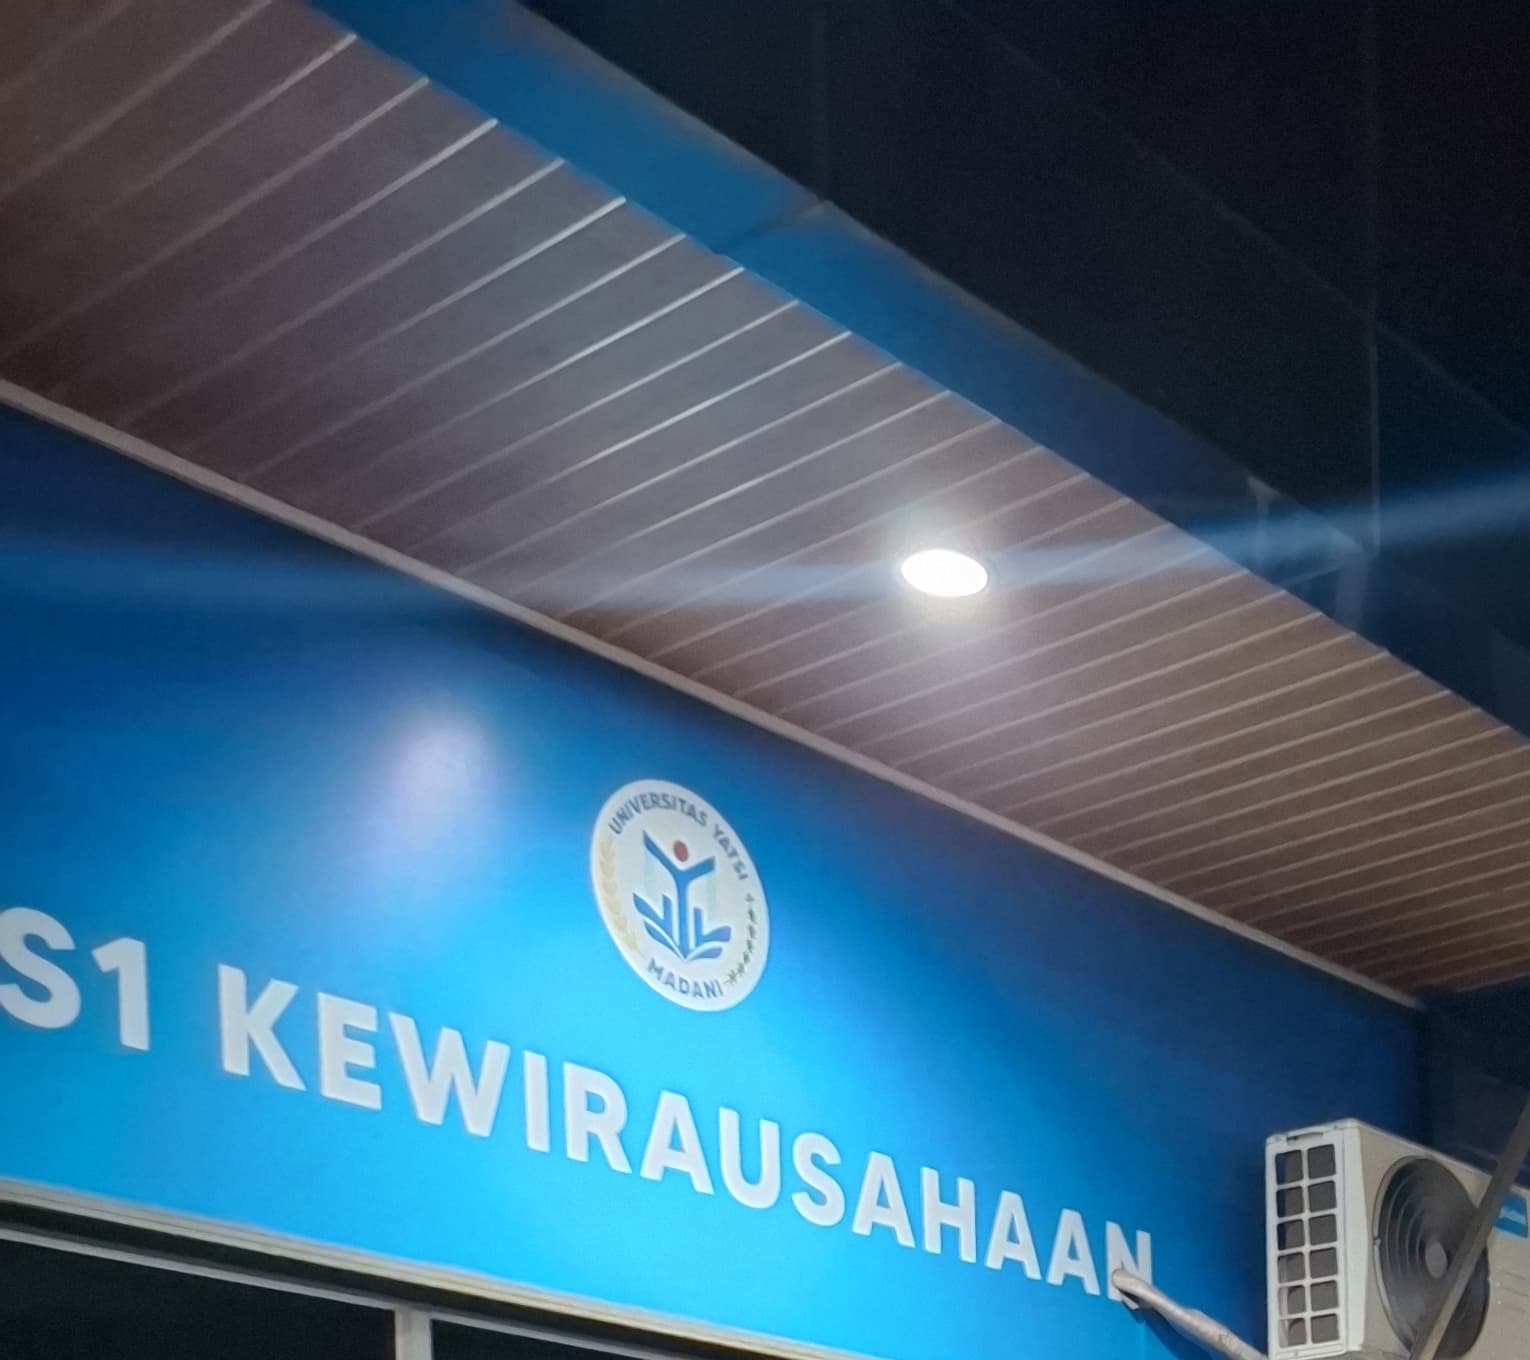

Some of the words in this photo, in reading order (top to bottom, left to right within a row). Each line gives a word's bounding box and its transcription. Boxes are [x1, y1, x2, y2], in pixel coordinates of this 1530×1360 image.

[608, 791, 708, 835] UNIVERSITAS
[713, 823, 749, 881] YATSI
[647, 957, 724, 999] MADANI
[0, 907, 150, 1052] S1
[215, 963, 1153, 1304] KEWIRAUSAHAAN
